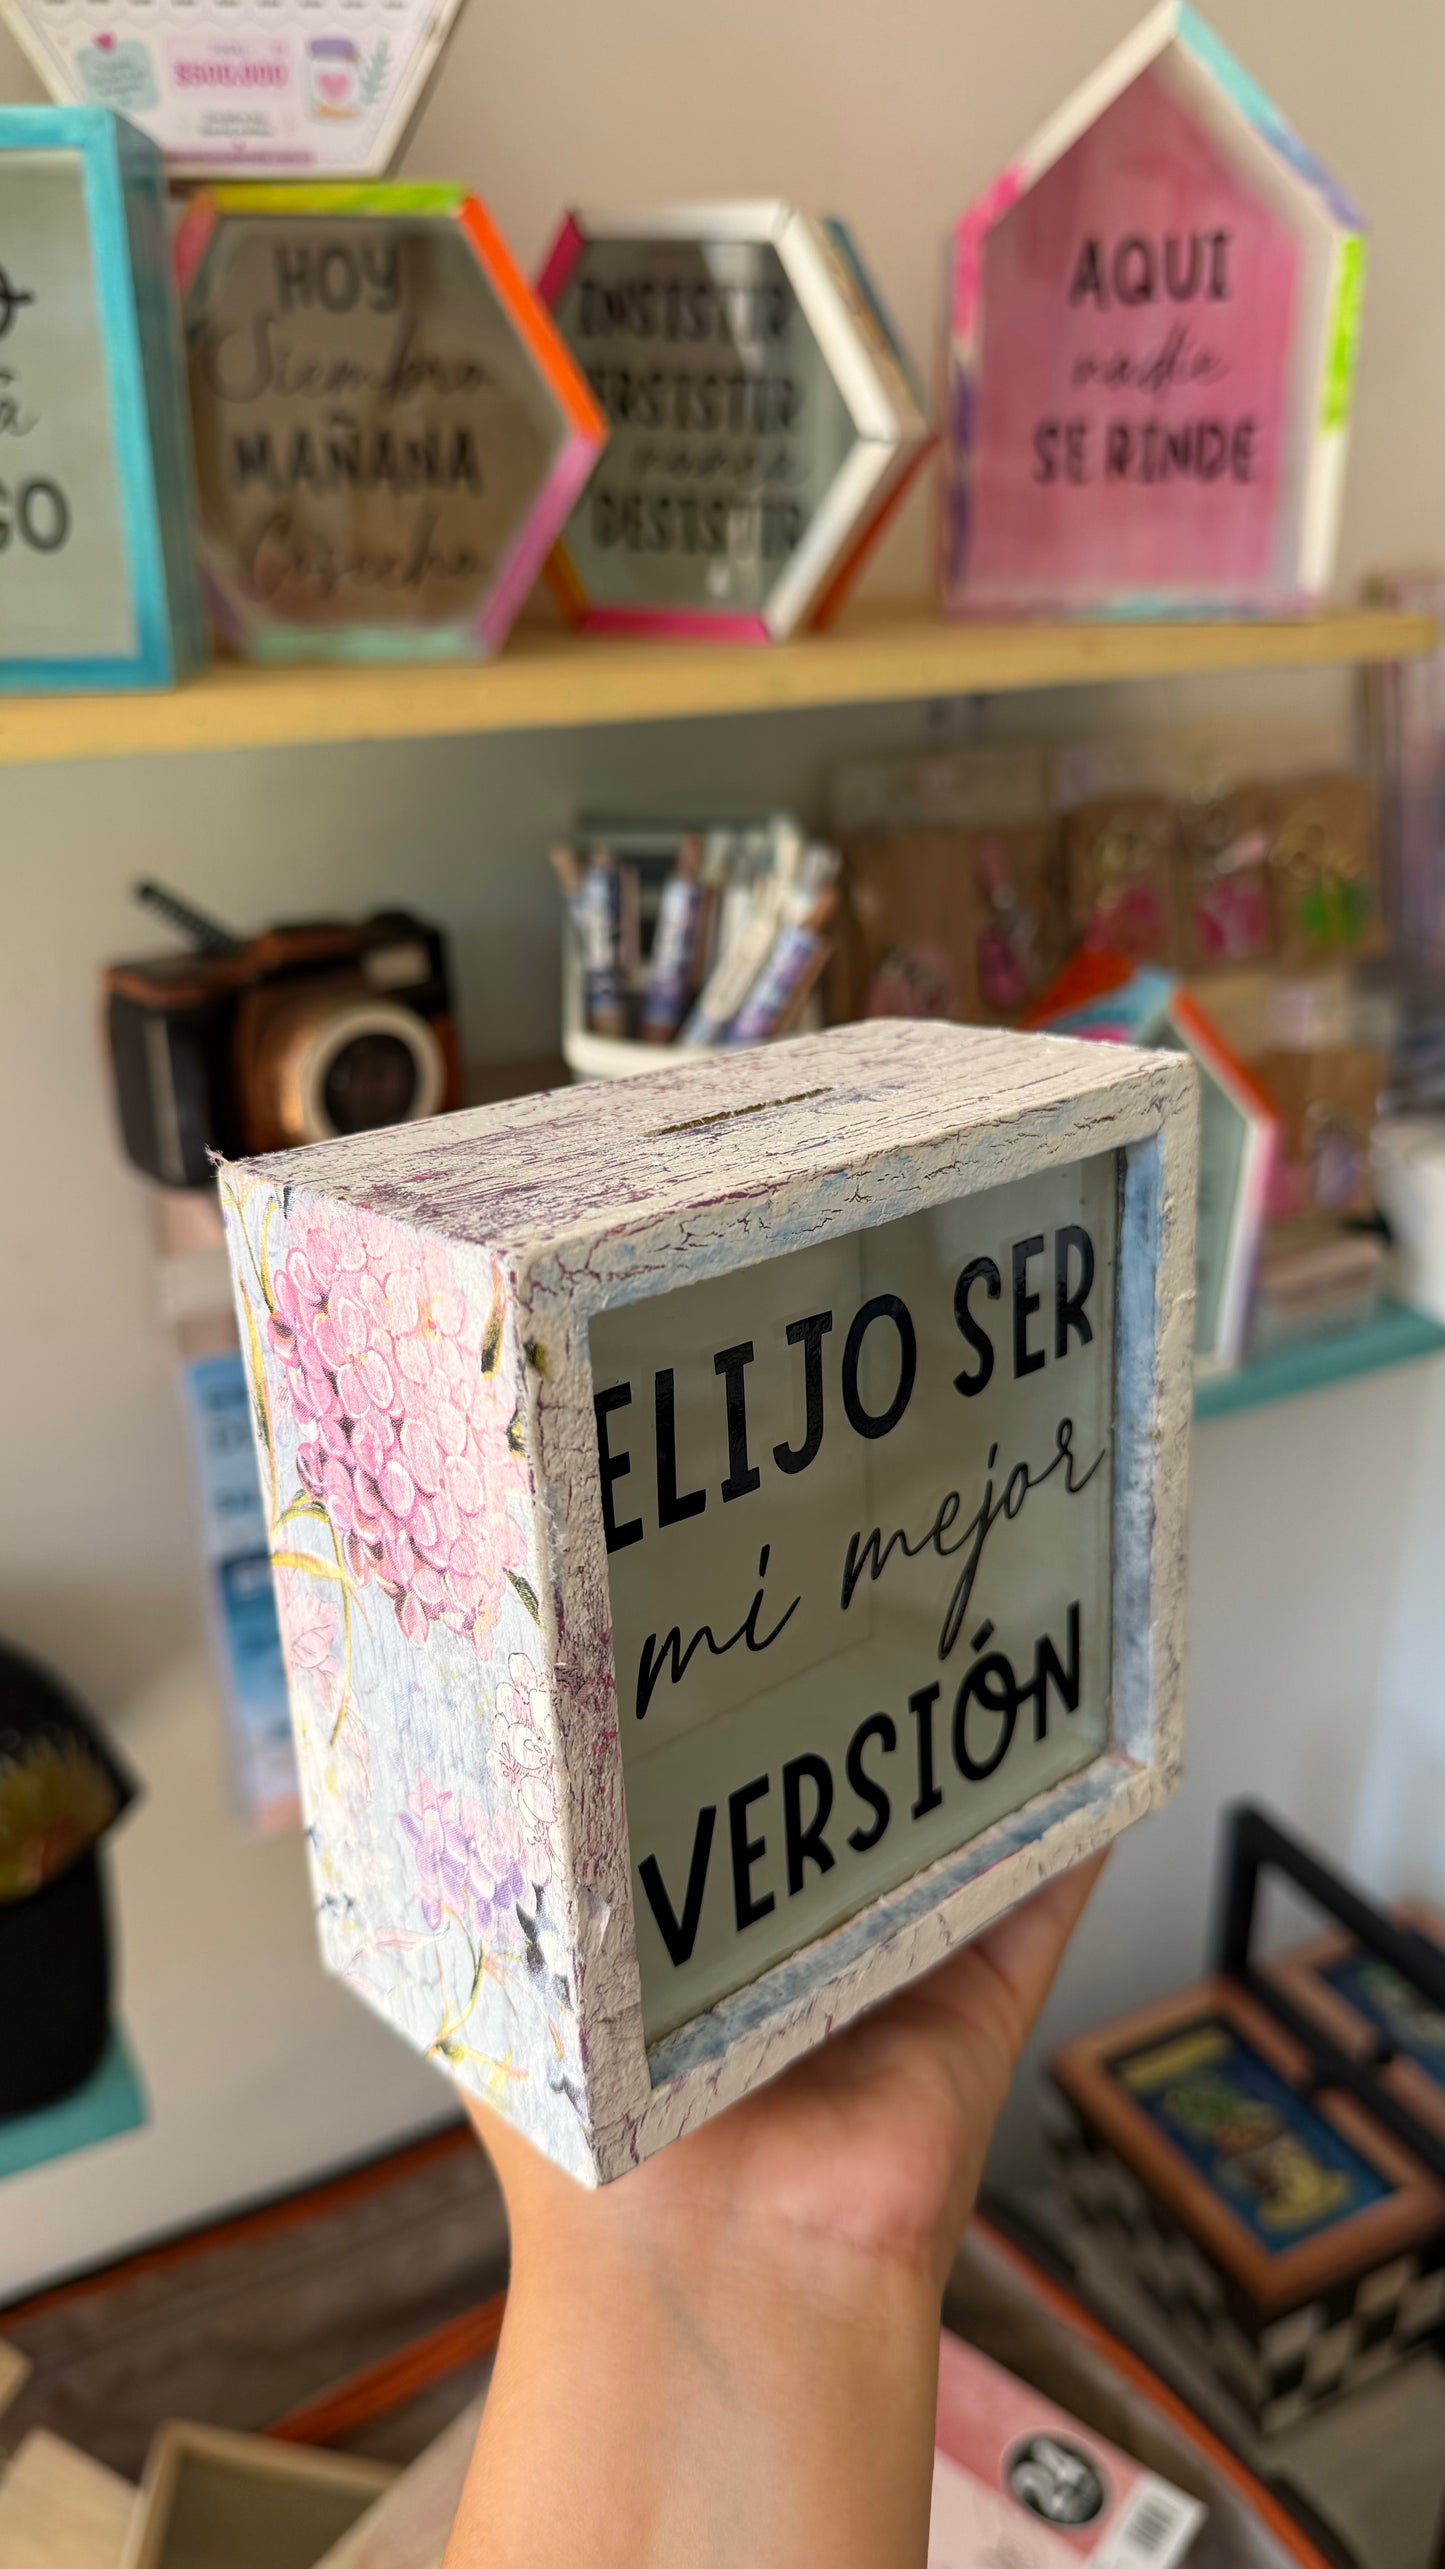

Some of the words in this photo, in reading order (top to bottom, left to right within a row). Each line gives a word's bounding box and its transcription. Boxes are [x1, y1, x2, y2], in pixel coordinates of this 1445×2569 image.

[274, 243, 400, 312] HOY
[578, 278, 797, 341] INSISTIR
[1067, 229, 1236, 311] AQUI
[1070, 320, 1234, 397] nadie
[230, 408, 485, 498] MAÑANA
[1033, 416, 1090, 484] SE
[1105, 415, 1259, 484] RINDE
[593, 1293, 917, 1555] ELIJO
[953, 1225, 1095, 1398] SER
[635, 1543, 800, 1720] mi
[841, 1417, 1106, 1660] mejor
[637, 1600, 1081, 1968] VERSIÓN
